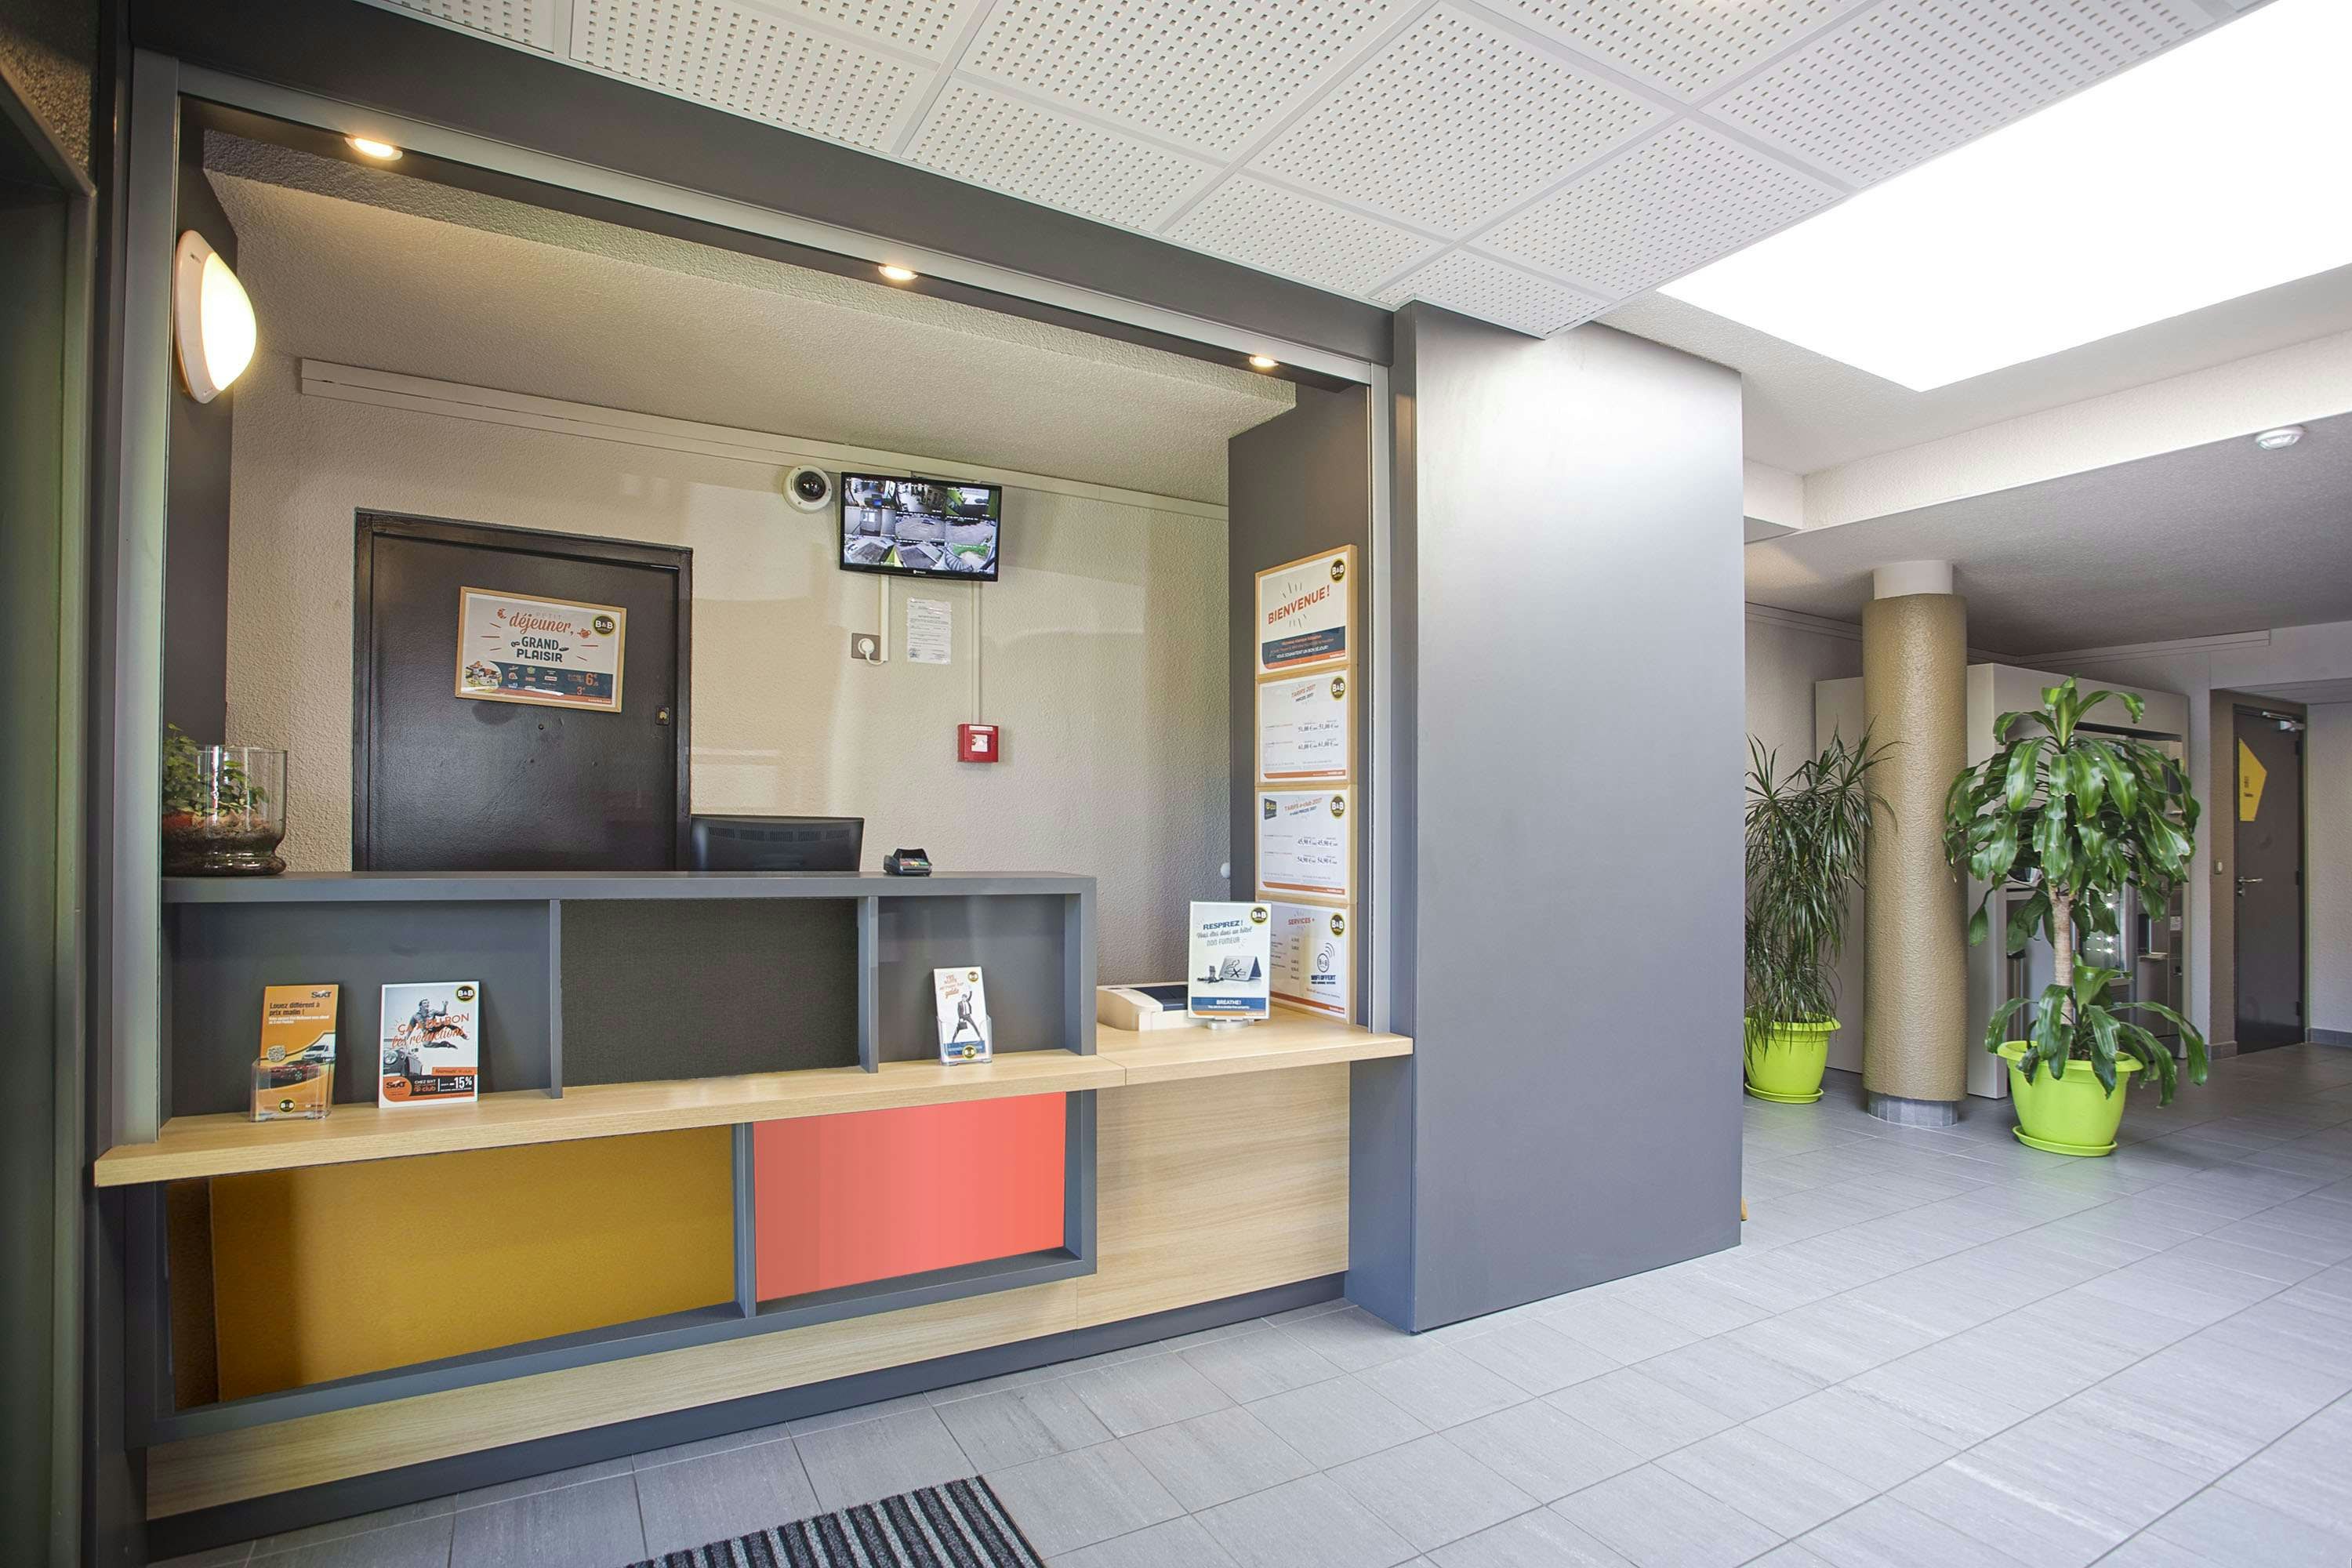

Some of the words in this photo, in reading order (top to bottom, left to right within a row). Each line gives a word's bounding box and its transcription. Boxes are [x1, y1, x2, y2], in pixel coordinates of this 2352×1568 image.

[509, 612, 574, 636] déjeuner,
[595, 619, 614, 630] B&B
[521, 636, 559, 651] GRAND
[516, 648, 563, 662] PLAISIR
[1203, 920, 1240, 930] RESPIREZ
[445, 1012, 470, 1026] BON
